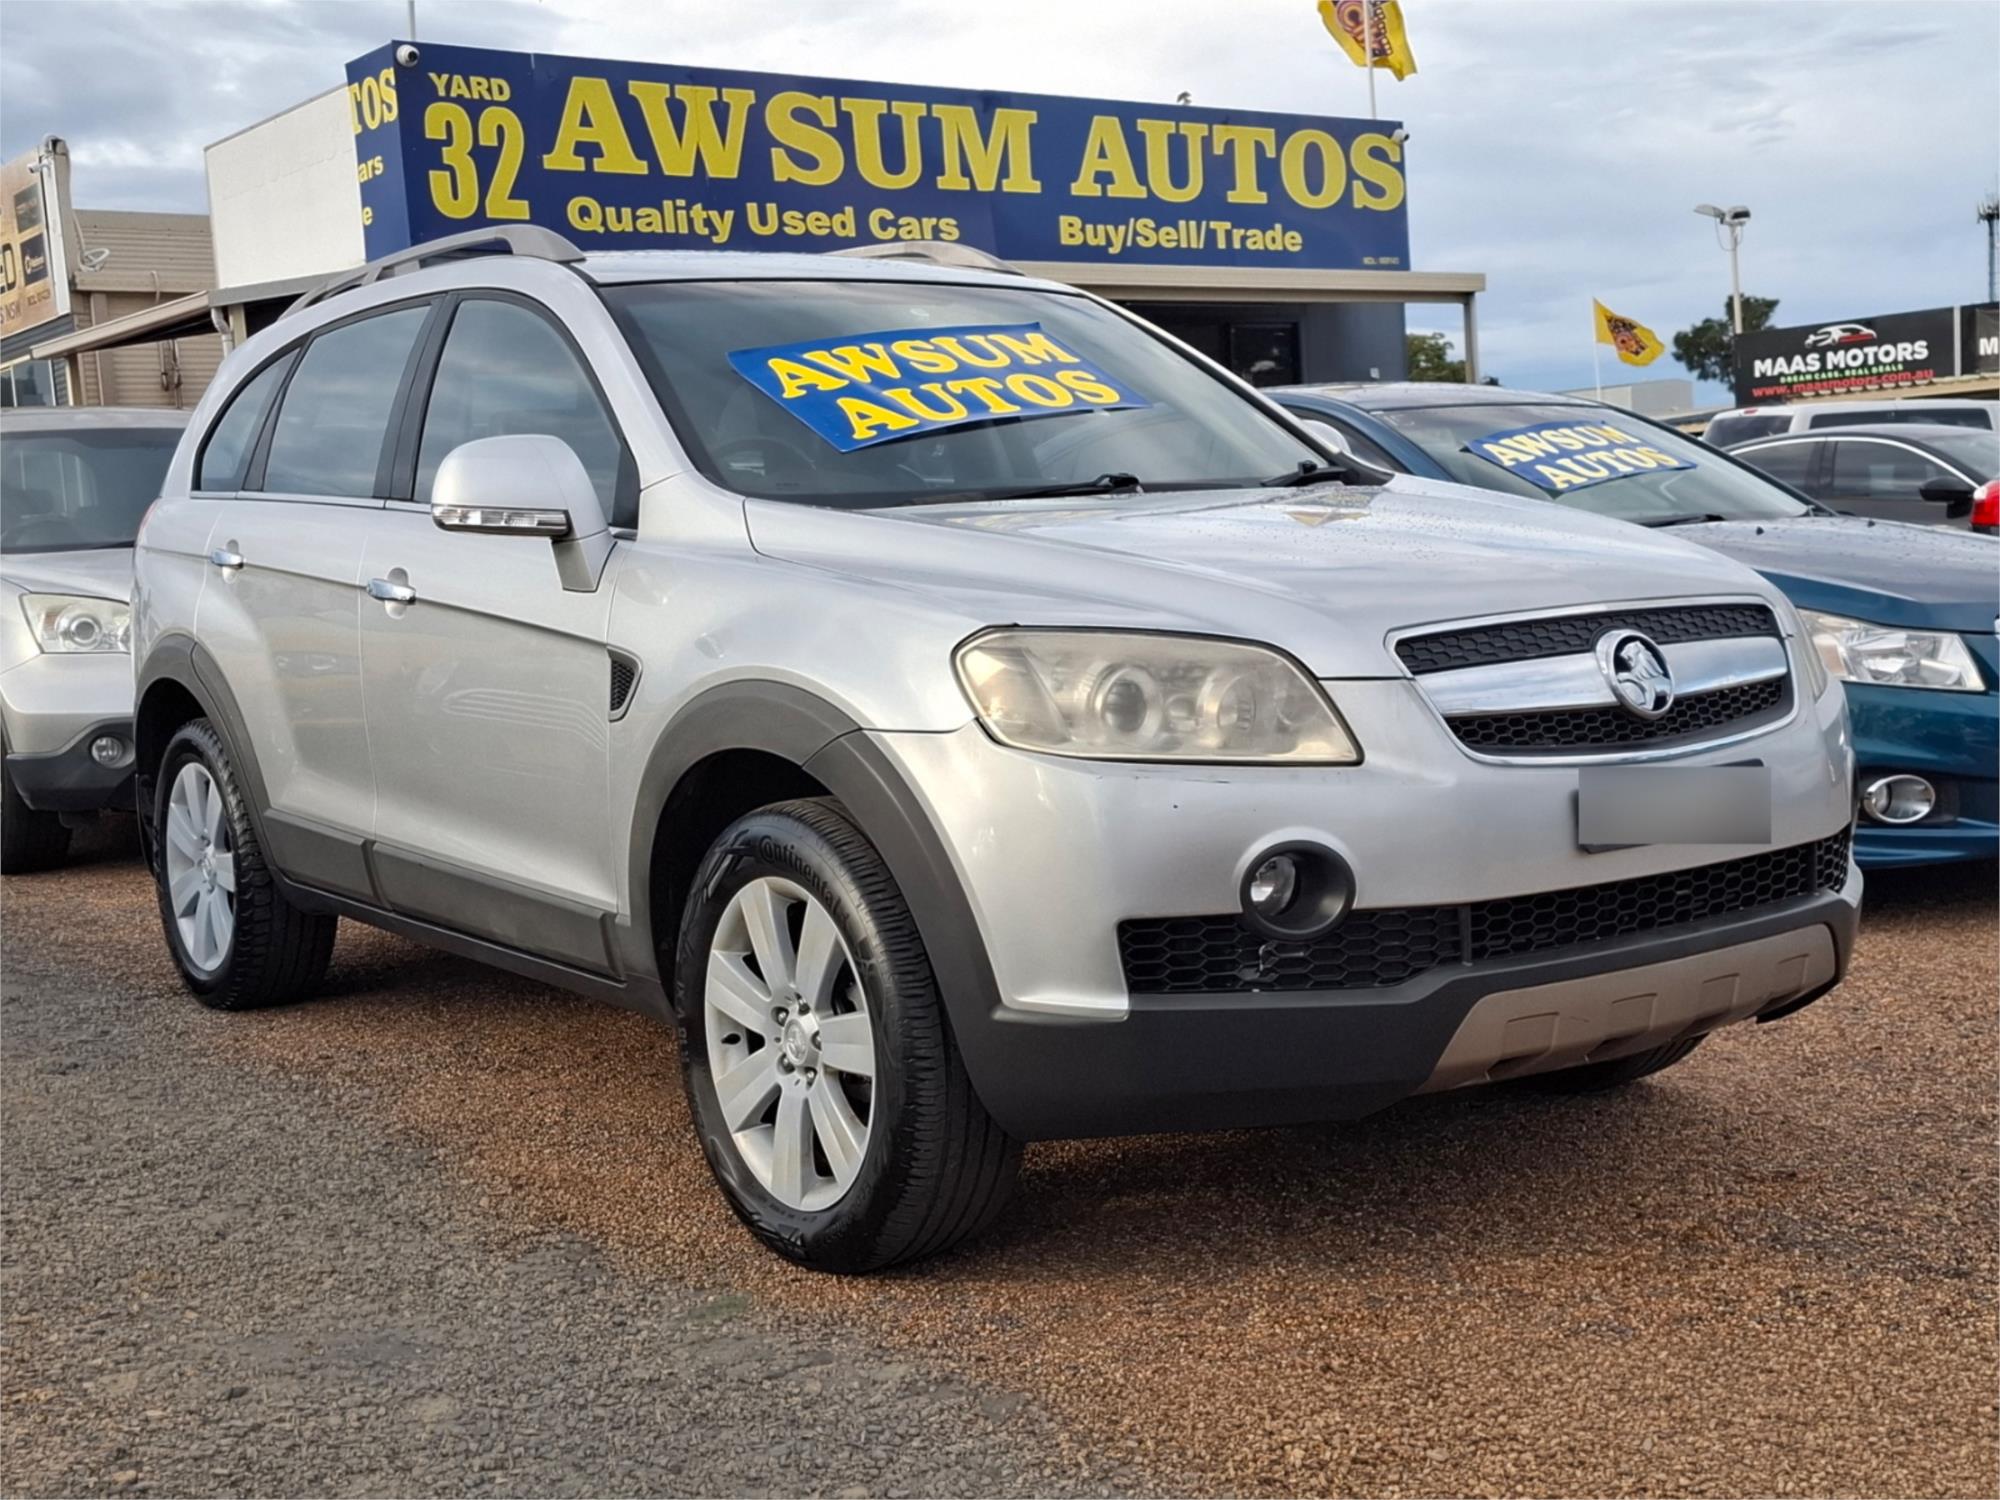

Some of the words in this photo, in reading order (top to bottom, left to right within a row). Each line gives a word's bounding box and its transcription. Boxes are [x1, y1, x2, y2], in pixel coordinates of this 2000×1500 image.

[428, 72, 511, 101] YARD
[424, 101, 530, 220] 32
[542, 76, 1042, 194] AWSUM
[1070, 115, 1405, 211] AUTOS
[566, 196, 734, 243] Quality
[746, 202, 856, 238] Used
[869, 208, 960, 241] Cars
[767, 332, 1081, 398] AWSUM
[1753, 353, 1821, 378] MAAS
[1826, 340, 1929, 370] MOTORS
[836, 370, 1121, 440] AUTOS
[1482, 425, 1641, 467] AWSUM
[1535, 446, 1681, 489] AUTOS
